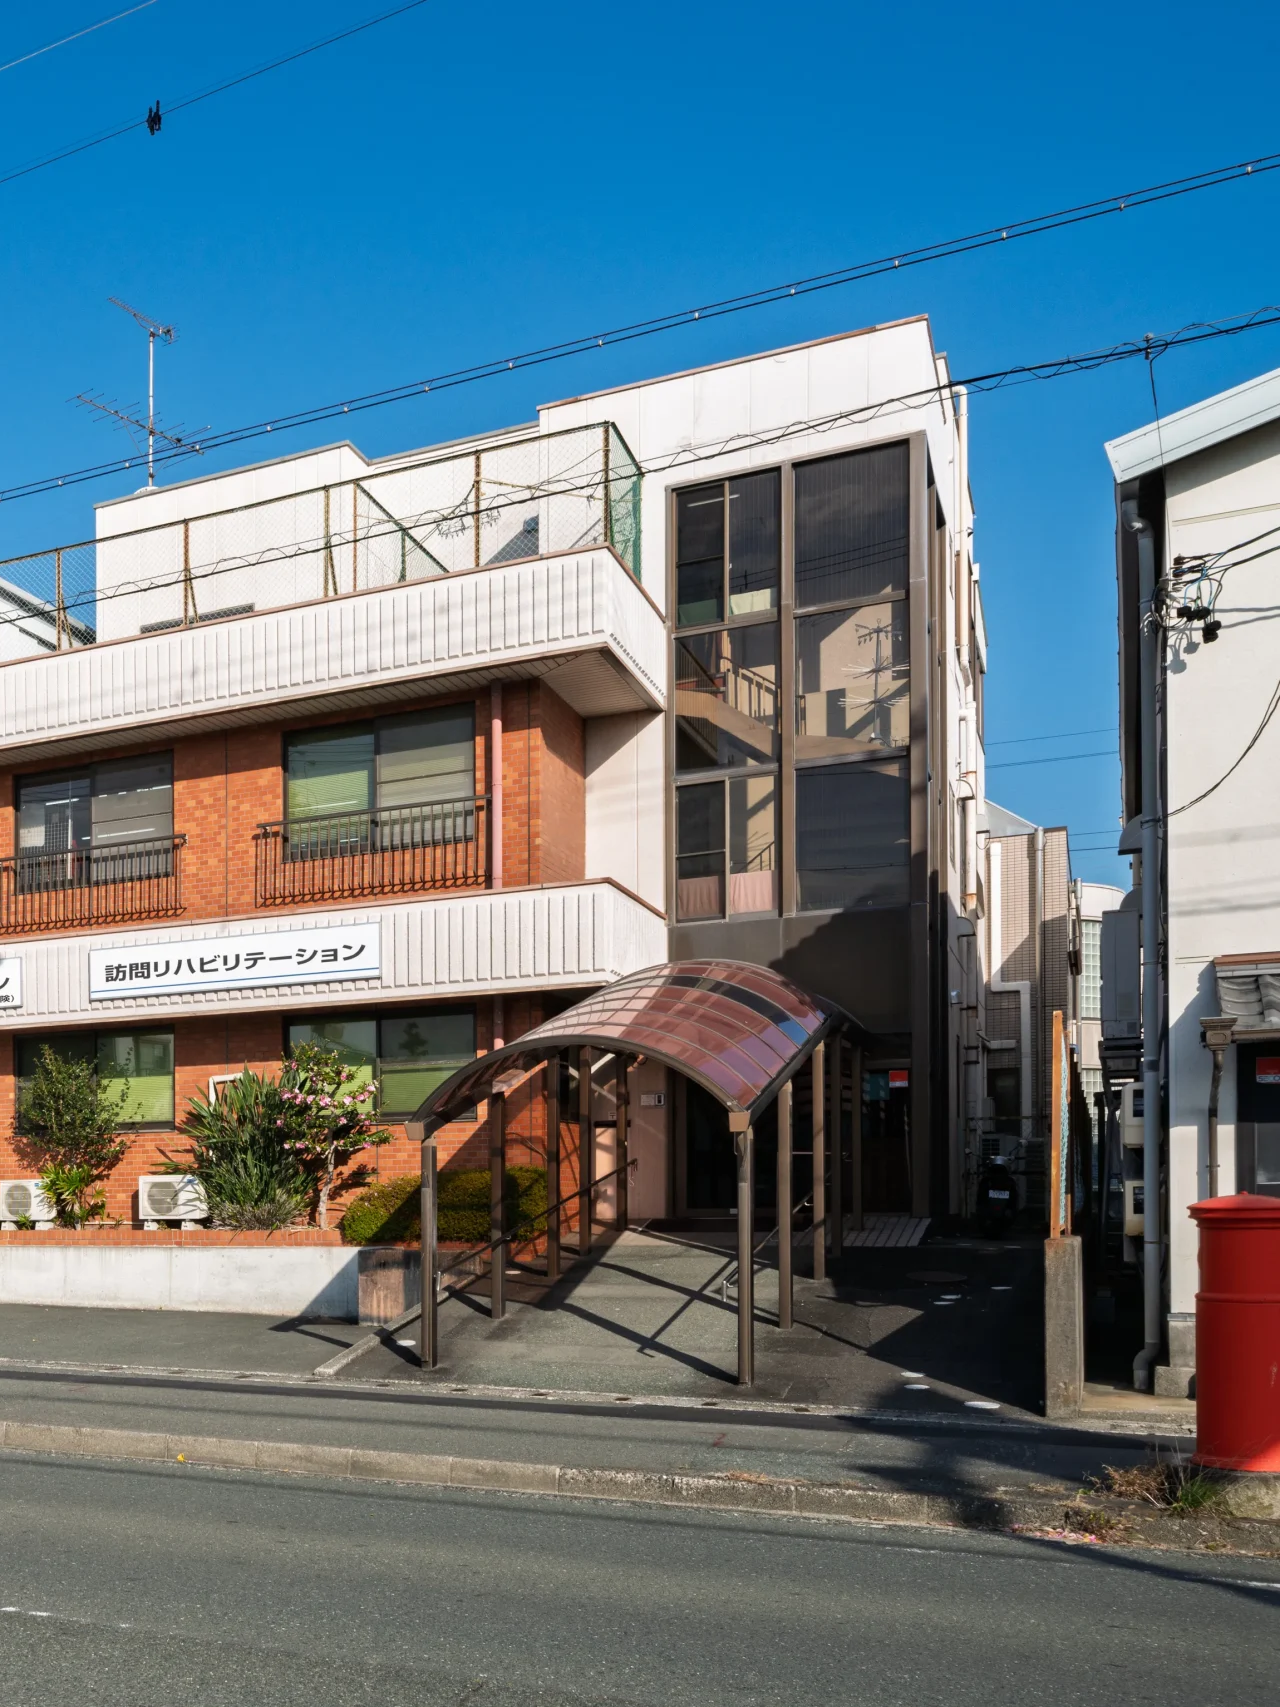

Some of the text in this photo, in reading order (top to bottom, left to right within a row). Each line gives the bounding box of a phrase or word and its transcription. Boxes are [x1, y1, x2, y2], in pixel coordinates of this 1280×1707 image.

[104, 943, 366, 983] 訪問リハビリテーション
